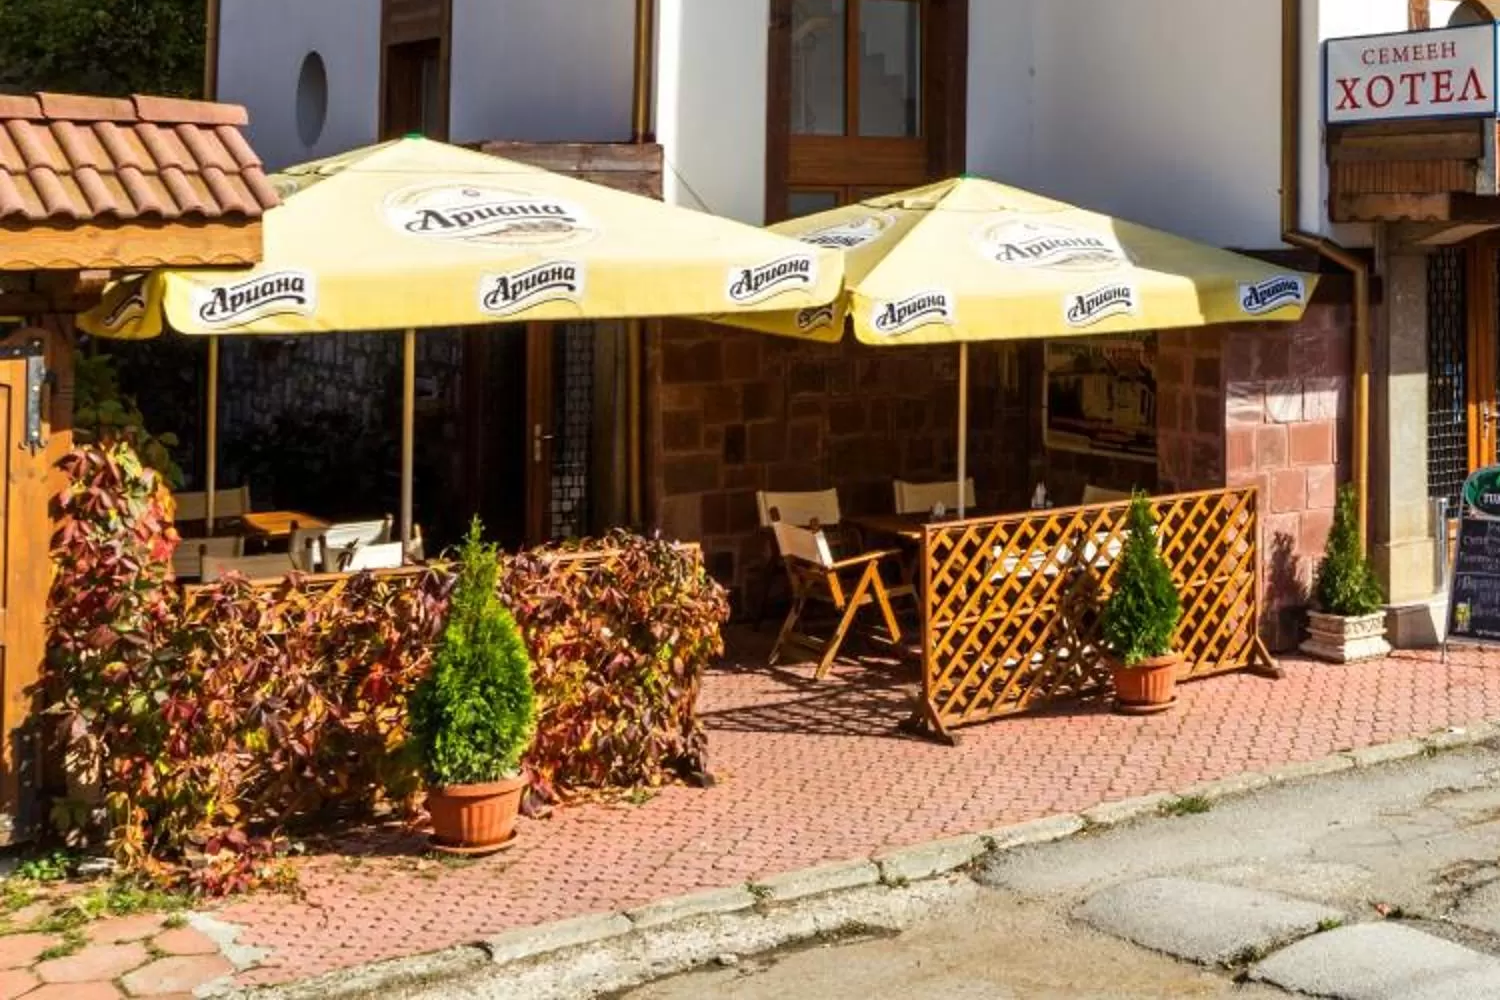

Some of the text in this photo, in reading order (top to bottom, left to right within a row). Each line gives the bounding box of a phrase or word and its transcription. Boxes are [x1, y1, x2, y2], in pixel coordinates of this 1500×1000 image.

[1361, 41, 1456, 65] СЕМЕЕН
[1335, 66, 1488, 111] ХОТЕЛ
[404, 203, 576, 234] Ариана
[995, 236, 1105, 262] Ариана
[484, 266, 576, 310] Ариана
[729, 257, 810, 301] Ариана
[199, 277, 306, 322] Ариана
[876, 293, 948, 331] Ариана
[1067, 286, 1133, 322] Ариана
